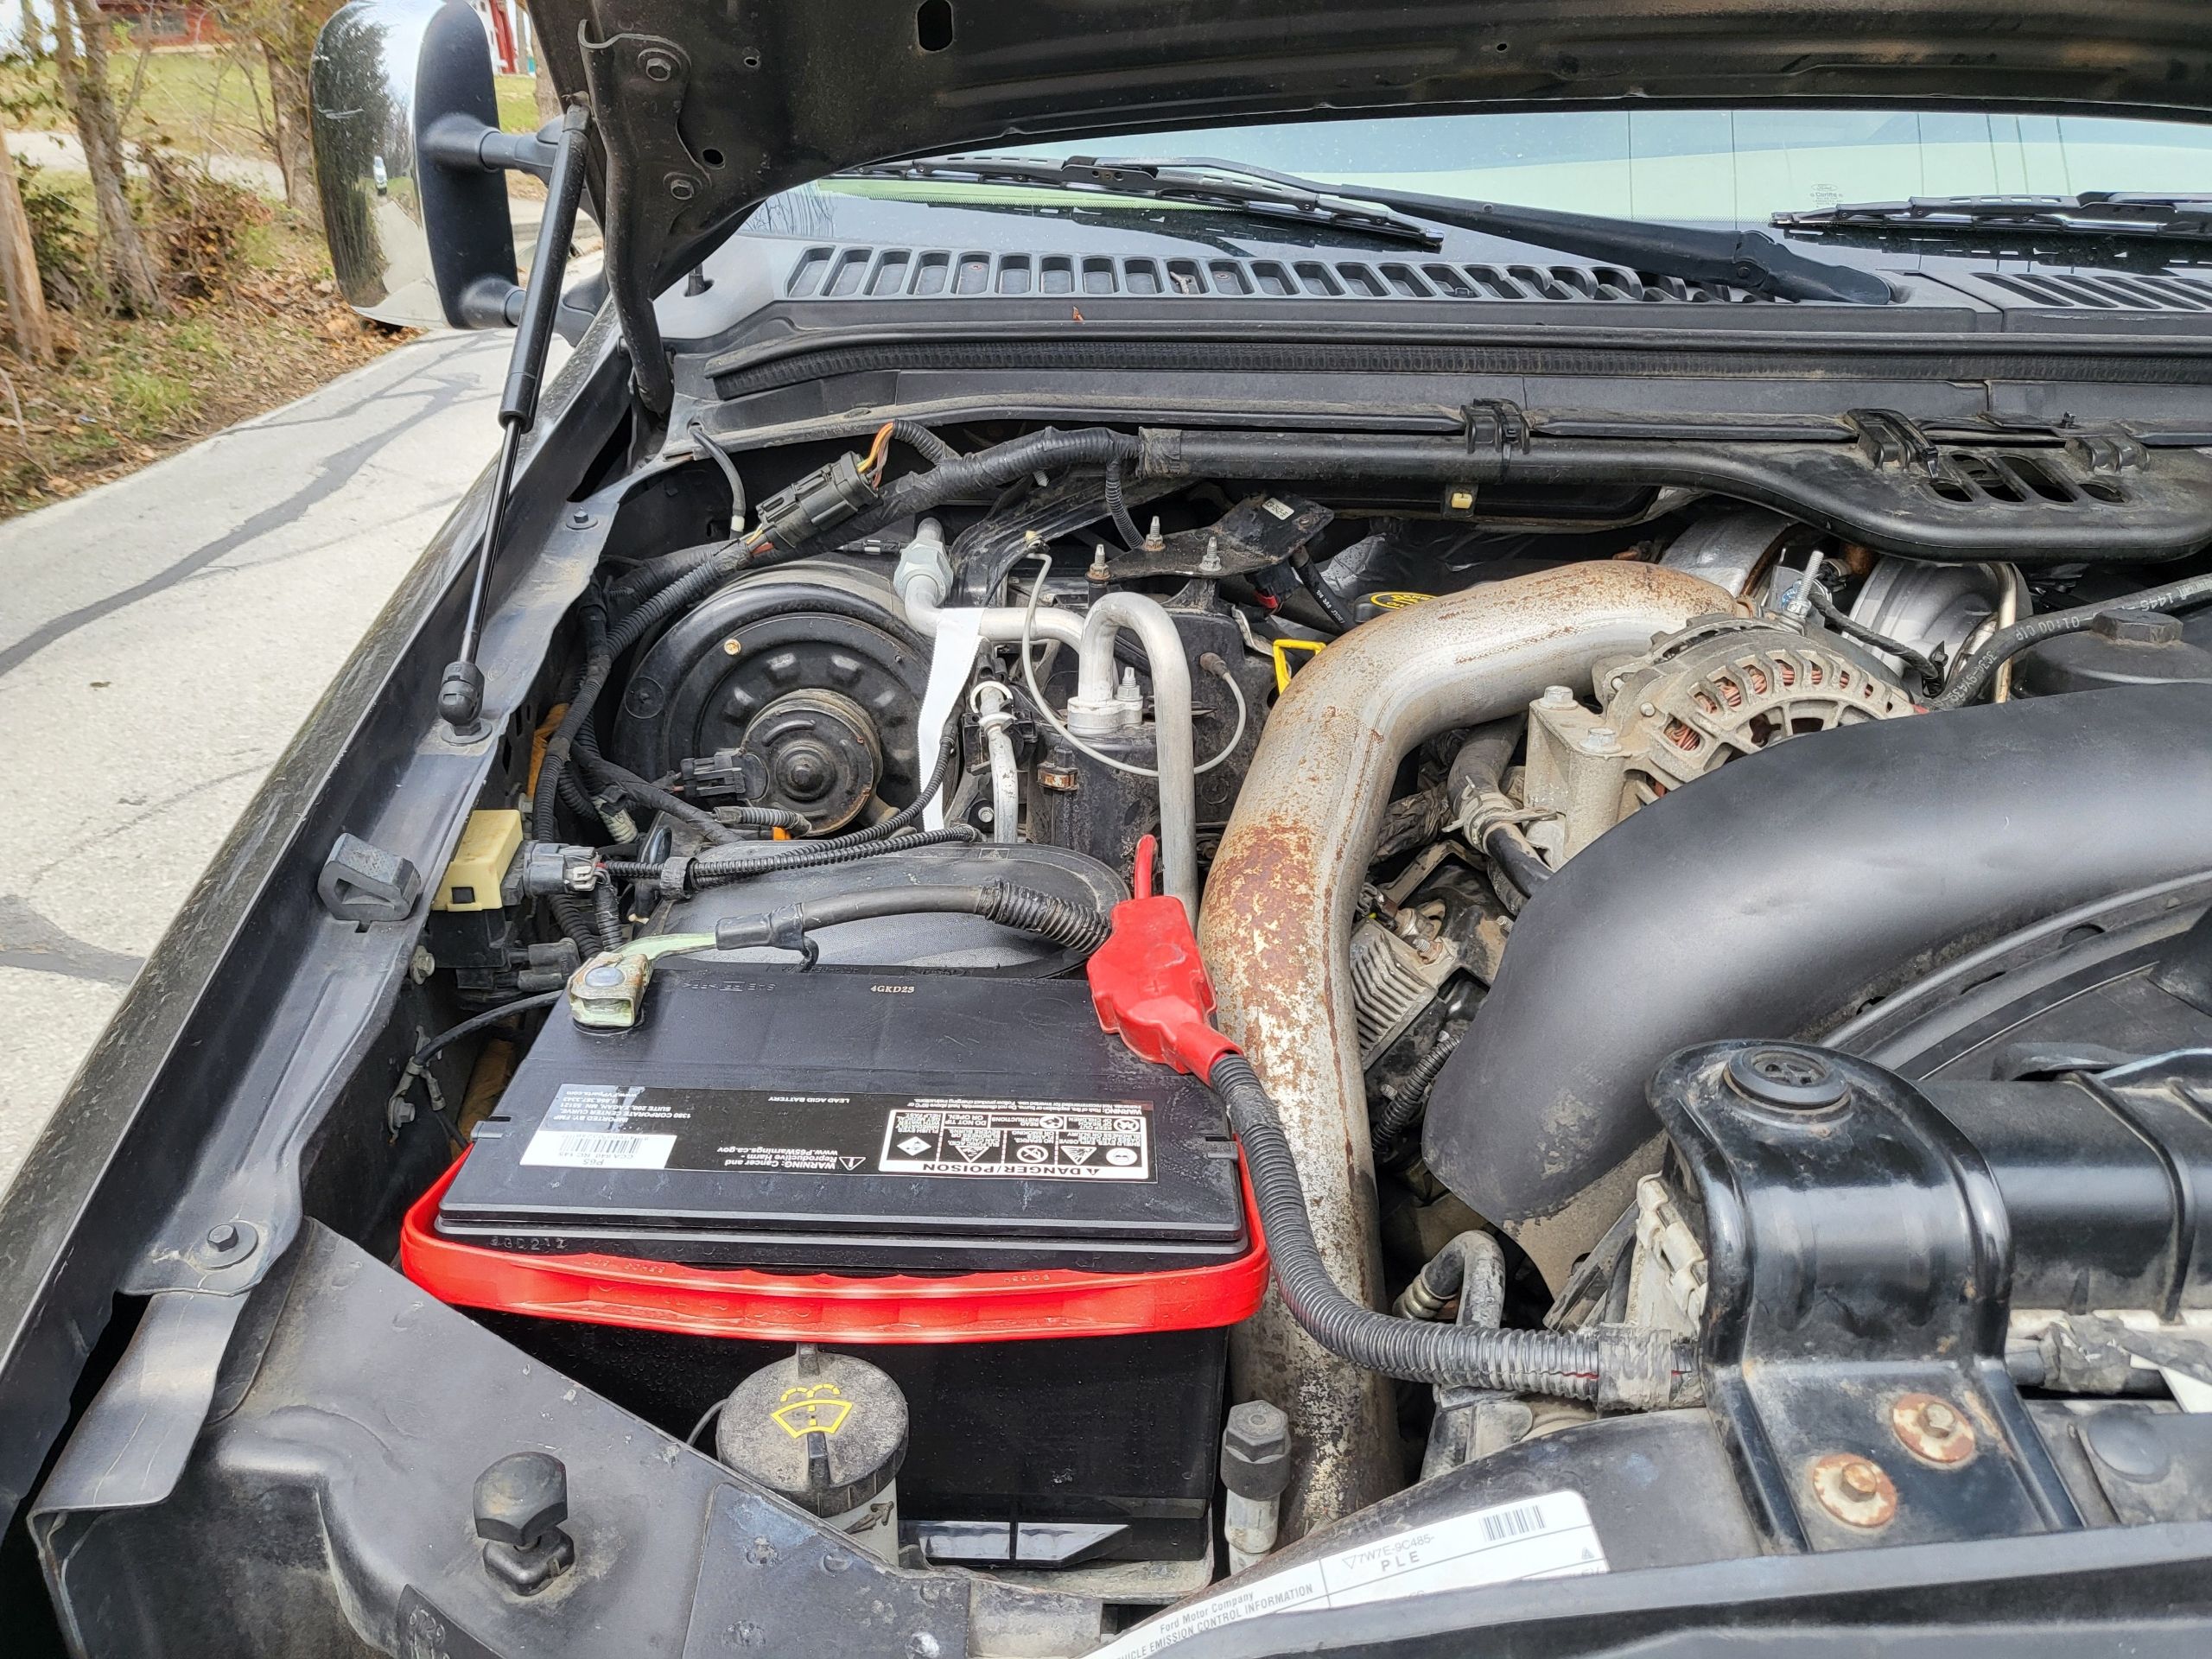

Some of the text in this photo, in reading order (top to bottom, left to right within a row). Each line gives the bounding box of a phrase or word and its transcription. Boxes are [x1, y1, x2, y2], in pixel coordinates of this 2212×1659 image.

[717, 1146, 838, 1156] www.P65Warnings.ca.gov
[774, 1154, 837, 1163] Reproductive
[781, 1160, 835, 1170] WARNING:
[1149, 1627, 1195, 1652] EMISSION
[1197, 1608, 1243, 1631] CONTROL
[1244, 1583, 1313, 1615] INFORMATION
[1160, 1592, 1254, 1634] Ford Motor Company
